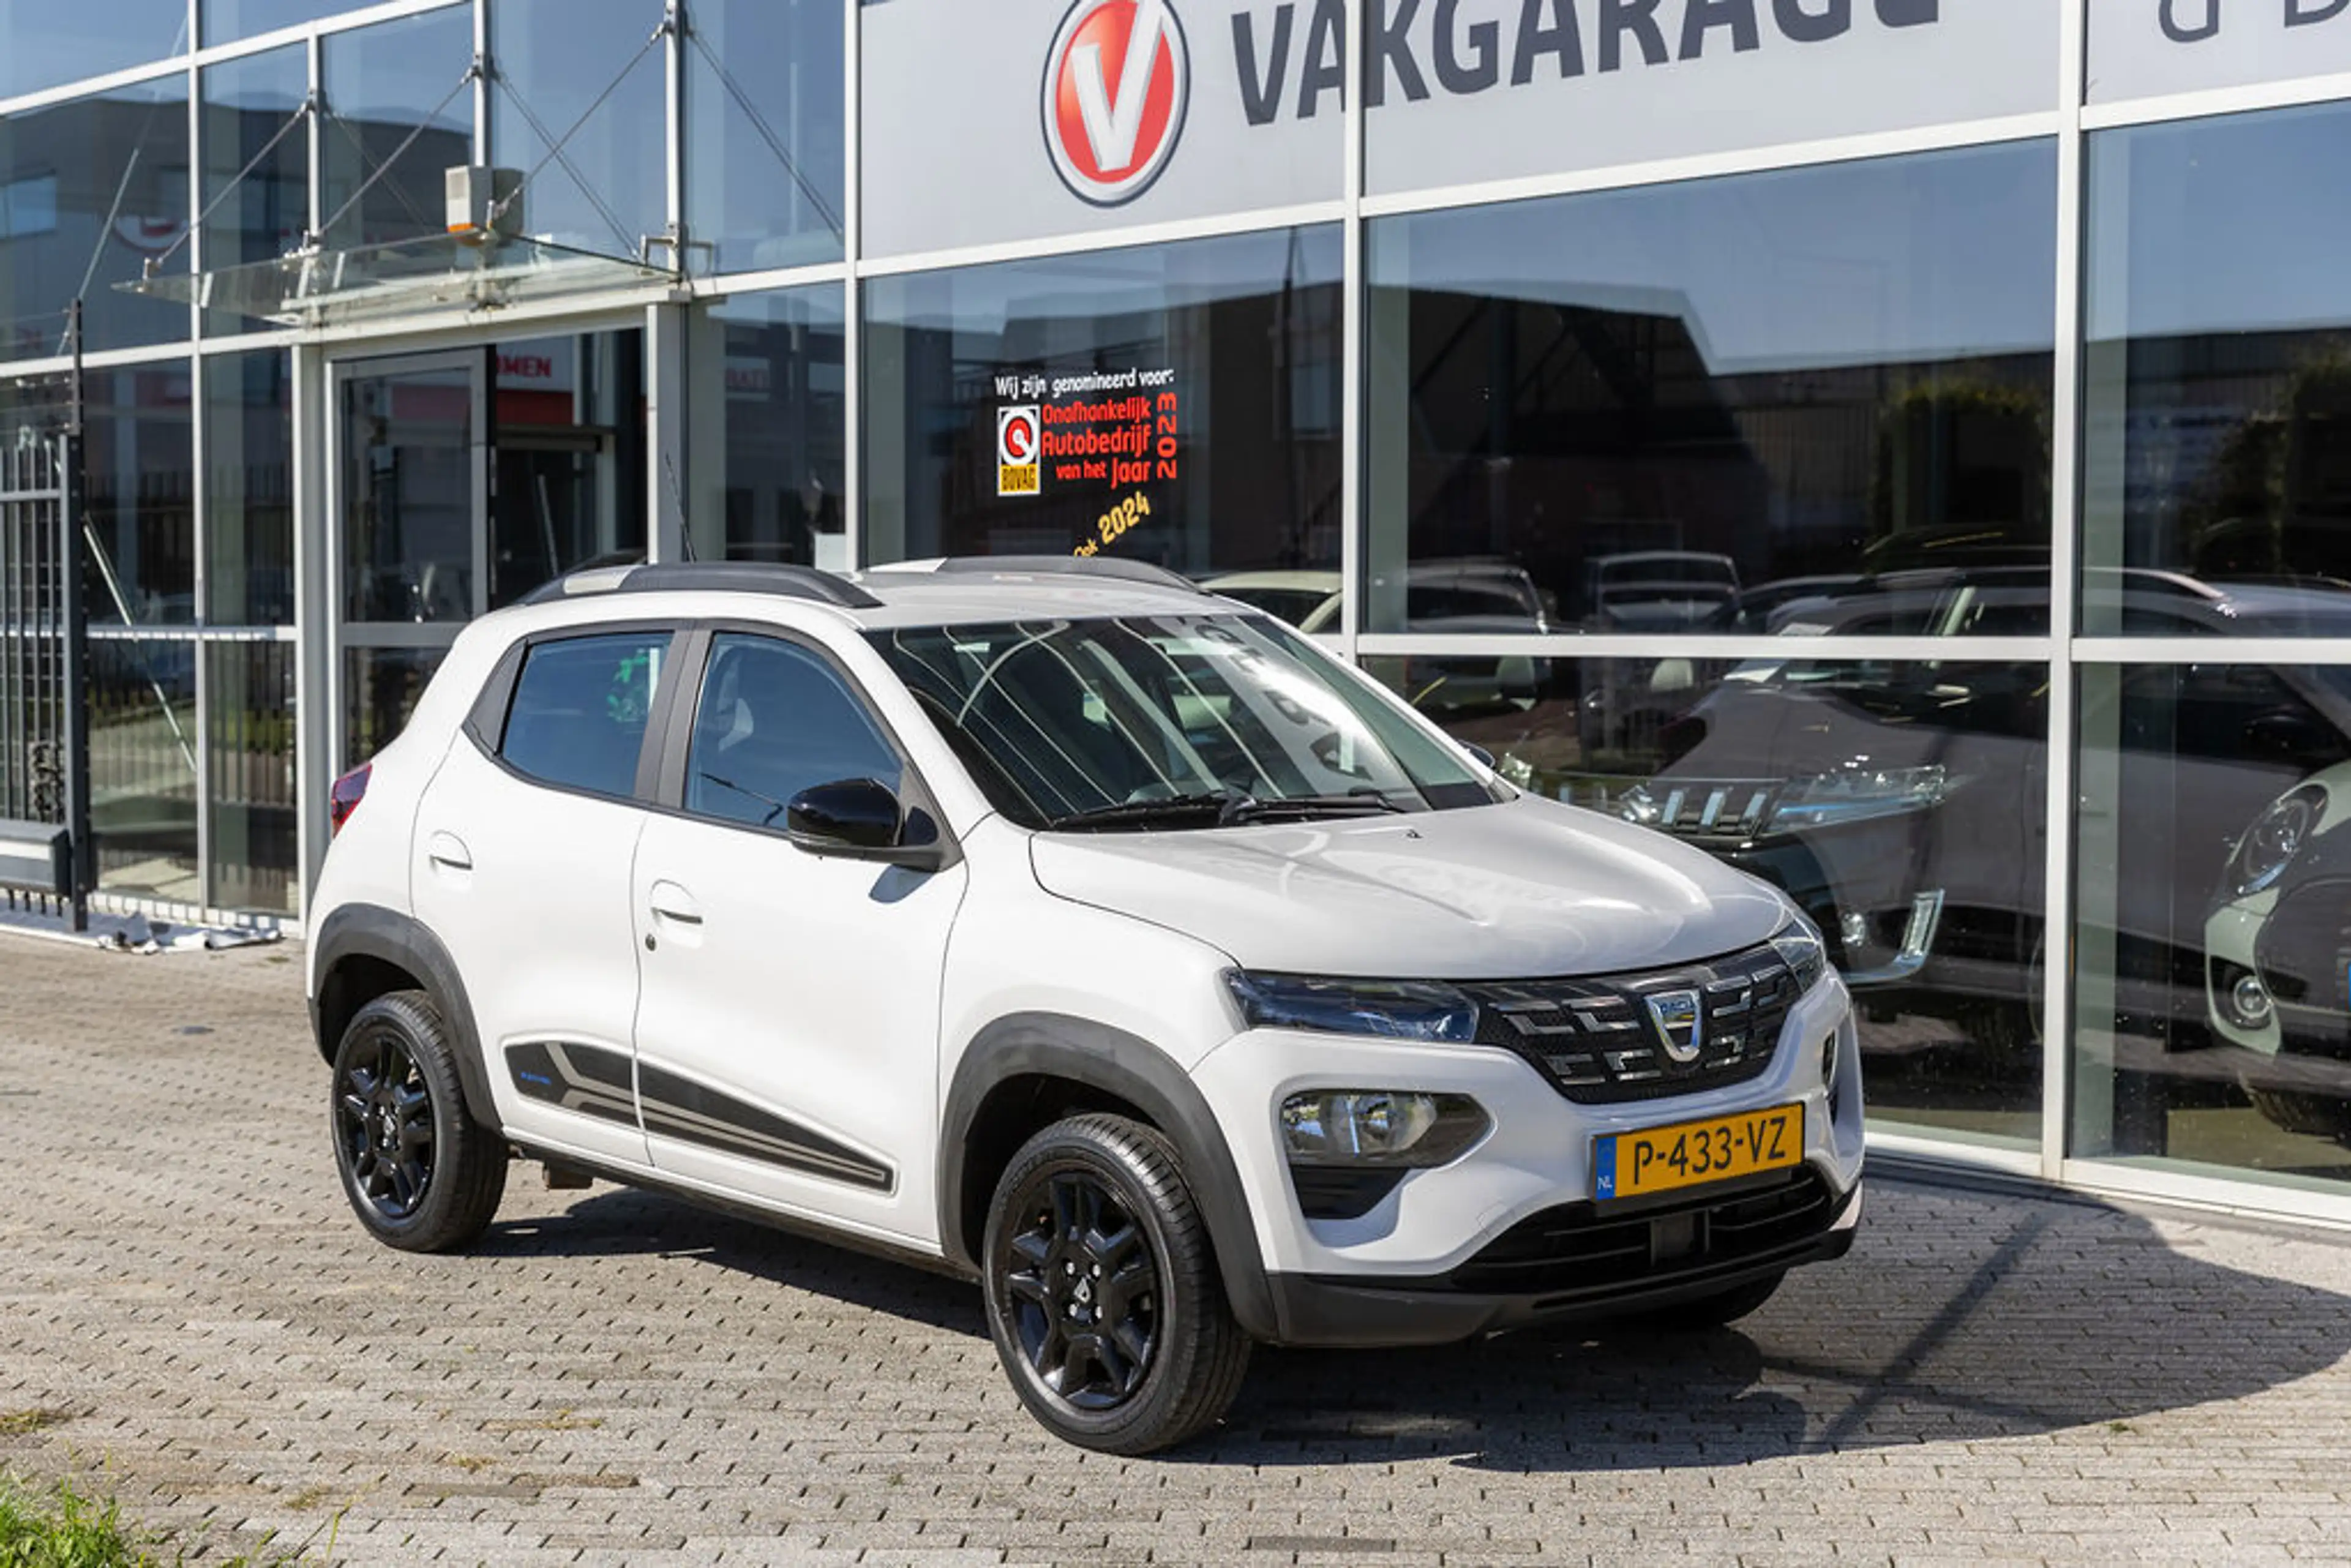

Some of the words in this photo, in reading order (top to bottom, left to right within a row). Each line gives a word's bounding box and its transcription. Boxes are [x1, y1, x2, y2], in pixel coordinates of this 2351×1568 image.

[1231, 0, 1939, 126] VAKGARA
[995, 375, 1019, 400] Wij
[1021, 374, 1047, 399] zijn
[1052, 367, 1136, 399] genomineerd
[1138, 369, 1174, 386] voor:
[1042, 396, 1152, 424] Onafhankelijk
[1042, 424, 1152, 458] Autobedrijf
[1157, 391, 1177, 479] 2023
[1001, 463, 1036, 491] BOVAG
[1056, 463, 1081, 480] van
[1083, 460, 1107, 479] het
[1110, 457, 1152, 490] Jaar
[1097, 490, 1152, 545] 2024
[1633, 1116, 1787, 1185] P-433-VZ
[1597, 1175, 1613, 1191] NL
